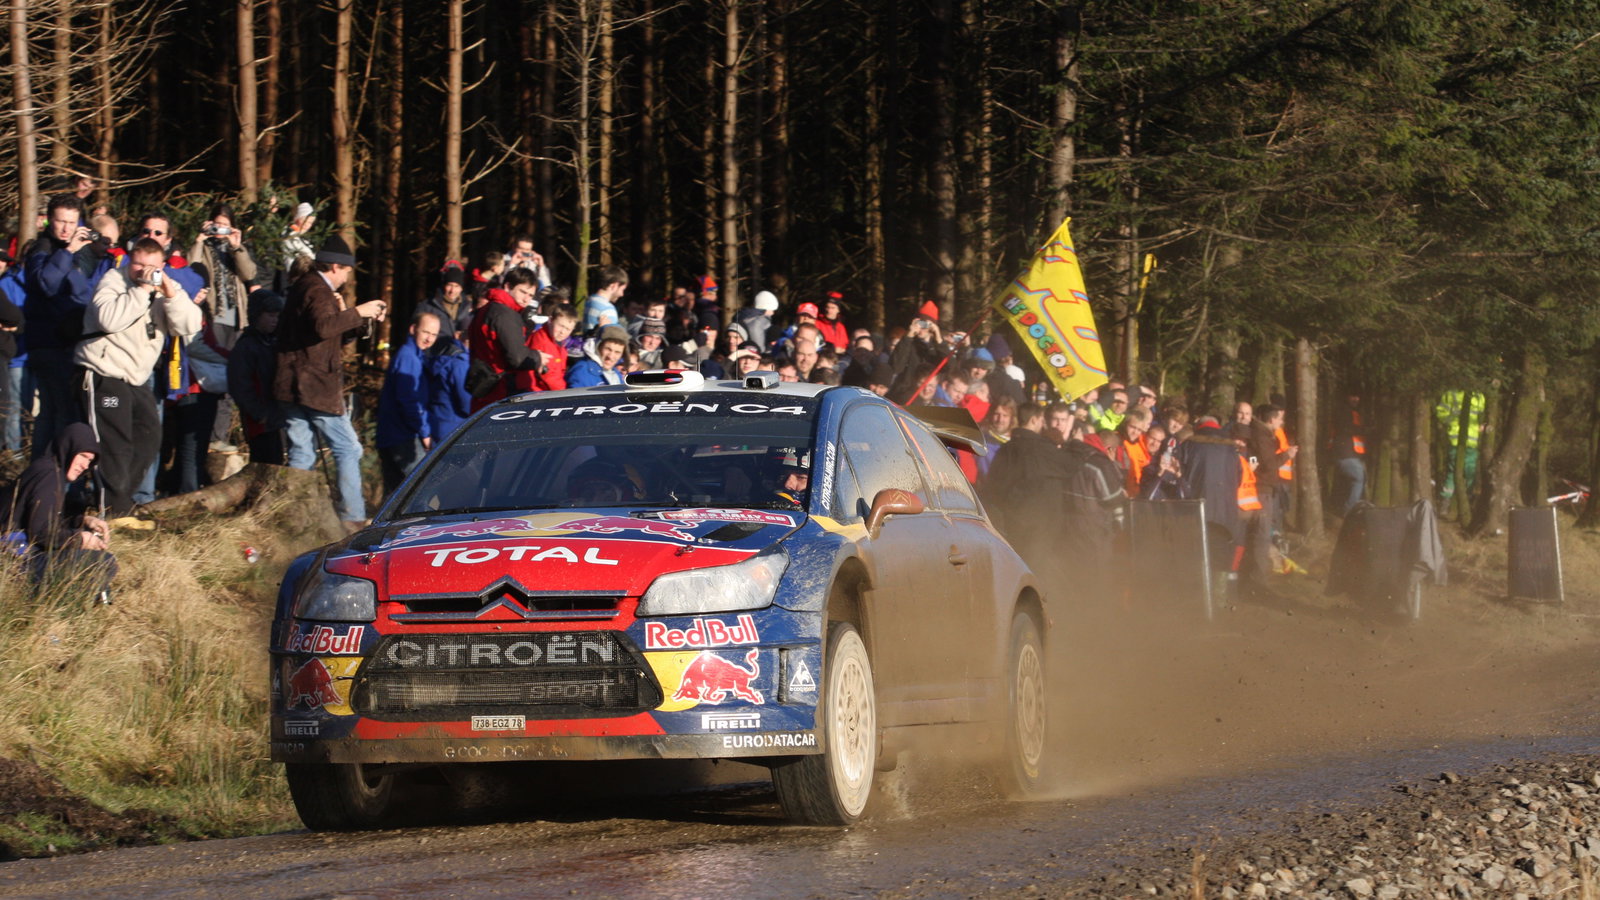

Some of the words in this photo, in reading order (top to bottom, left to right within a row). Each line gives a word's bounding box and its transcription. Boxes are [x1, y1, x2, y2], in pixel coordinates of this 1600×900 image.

[1018, 312, 1076, 380] DOCTOR
[490, 401, 719, 420] CITROËN
[730, 404, 807, 415] C4
[424, 546, 619, 567] TOTAL
[313, 625, 365, 655] Bull
[645, 618, 707, 650] Red
[705, 614, 760, 647] Bull
[387, 635, 613, 666] CITROËN
[530, 683, 615, 699] SPORT
[284, 720, 319, 736] PIRELLI
[492, 718, 509, 728] EGZ
[701, 713, 761, 730] PIRELLI
[723, 734, 815, 748] EURODATACAR
